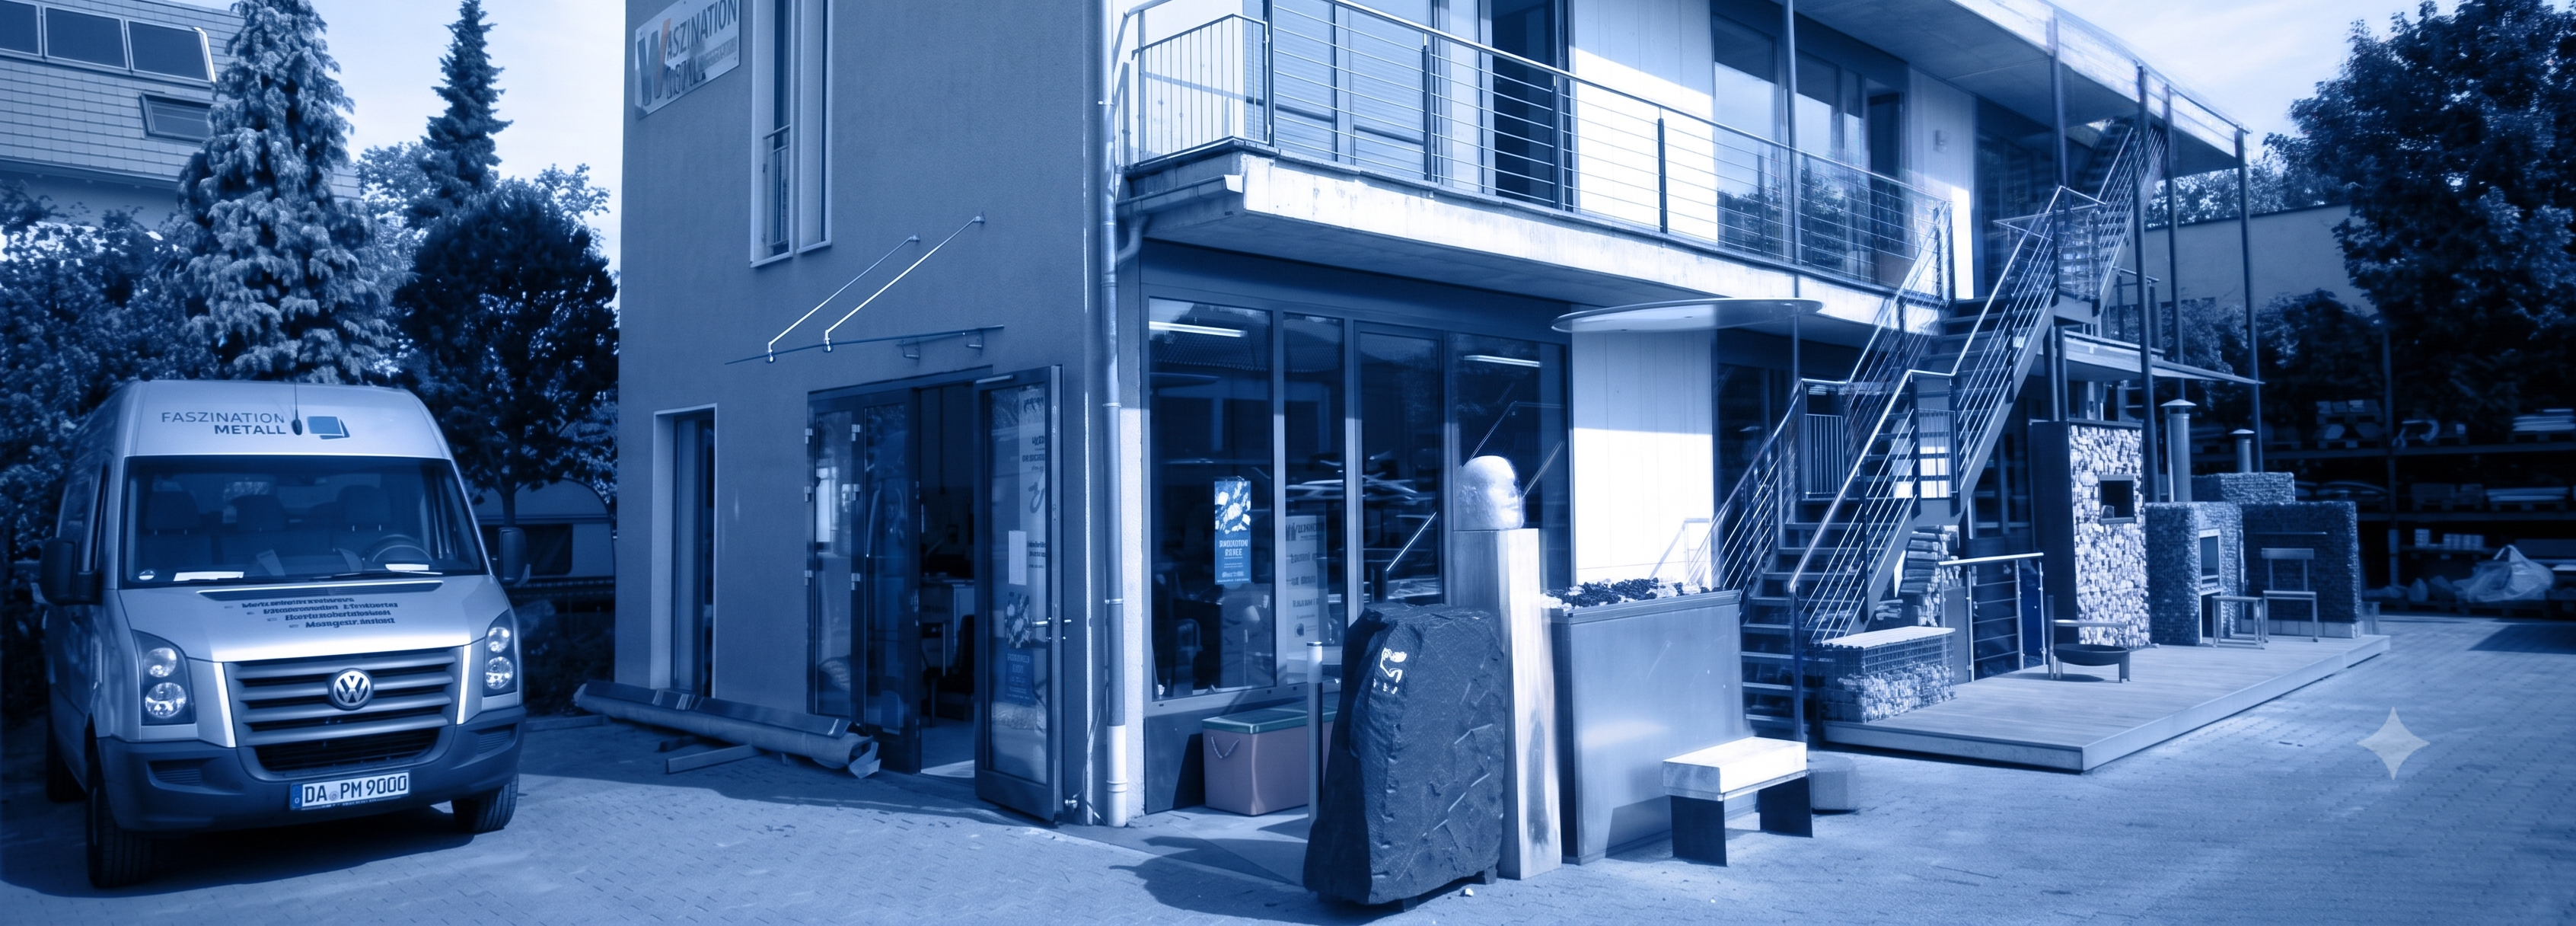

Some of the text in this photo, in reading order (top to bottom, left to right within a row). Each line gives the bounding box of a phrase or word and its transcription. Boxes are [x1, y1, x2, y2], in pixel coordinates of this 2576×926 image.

[161, 412, 285, 423] FASZINATION
[214, 425, 286, 434] METALL
[304, 775, 406, 803] DA PM 9000
